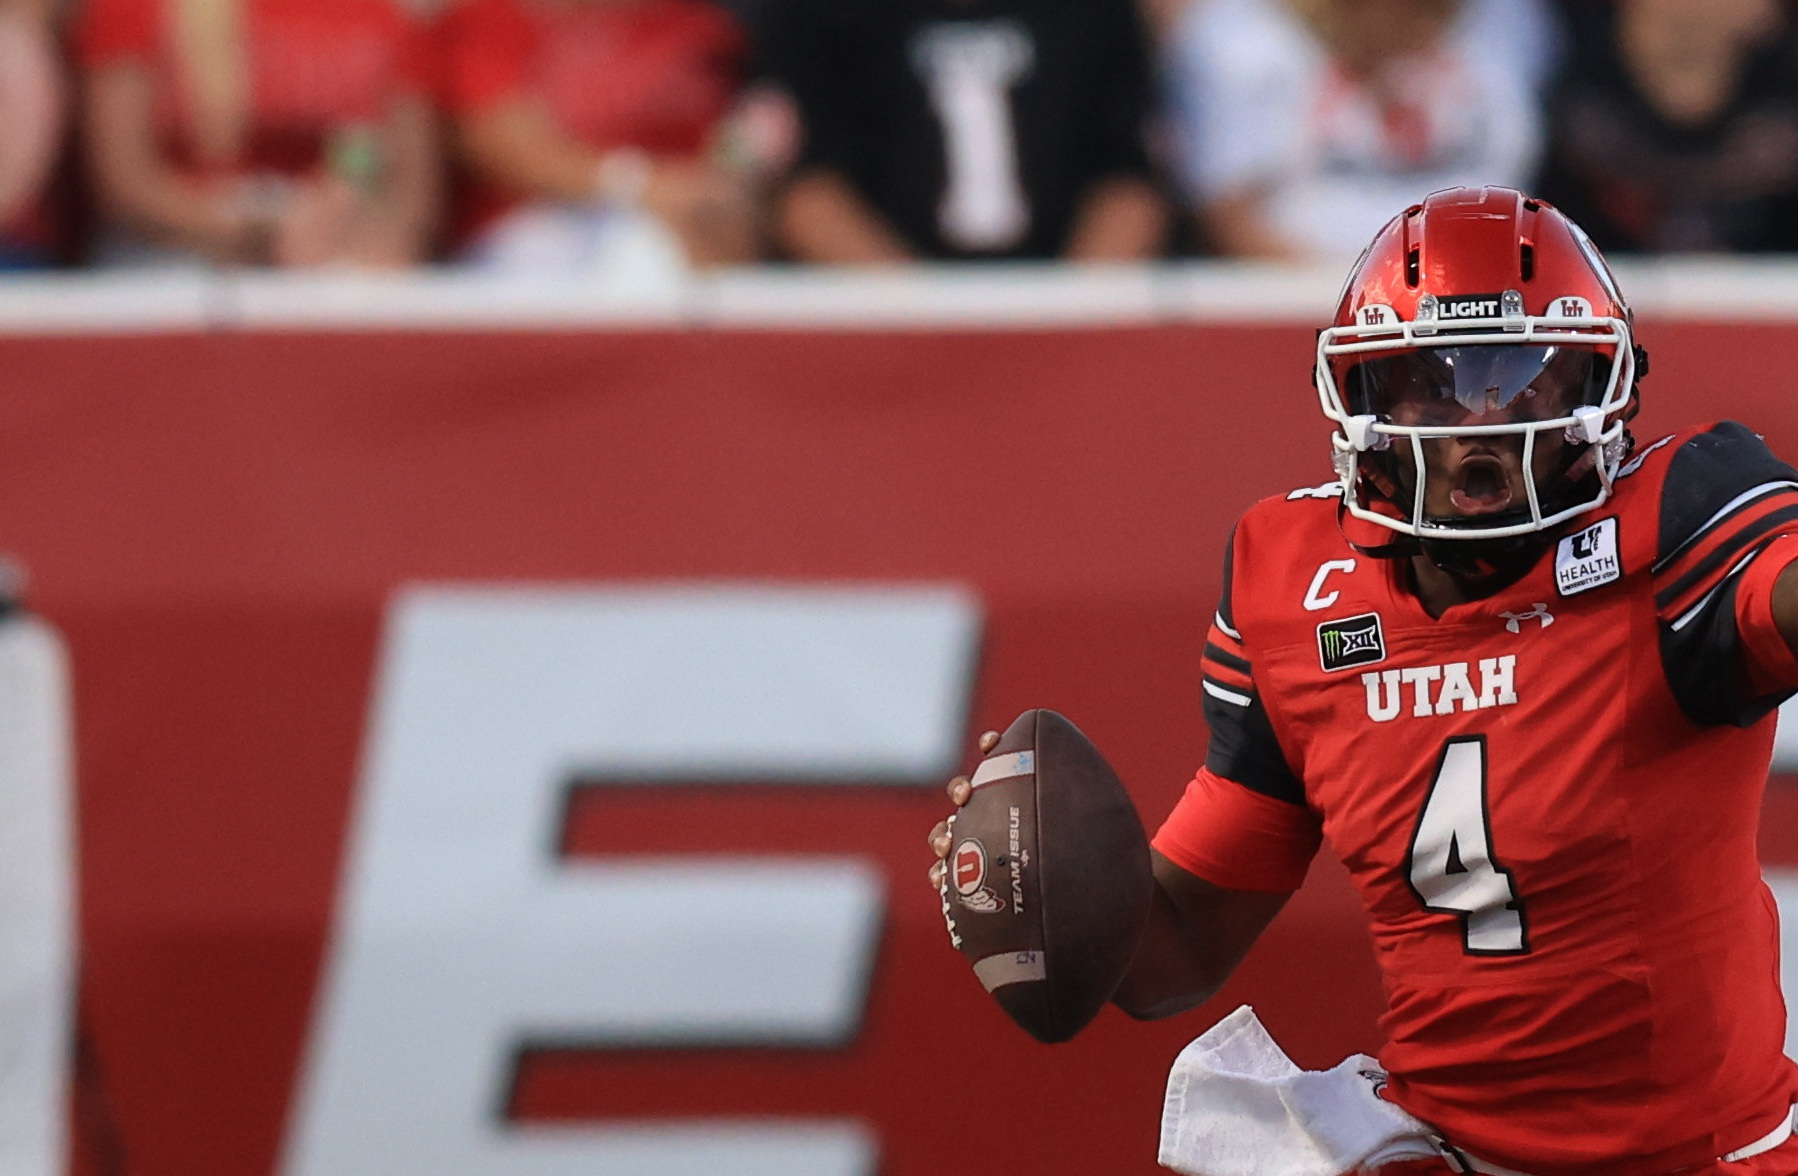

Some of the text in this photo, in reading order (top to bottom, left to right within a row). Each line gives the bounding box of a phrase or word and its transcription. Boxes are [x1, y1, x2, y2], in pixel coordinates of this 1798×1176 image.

[1439, 300, 1498, 318] LIGHT
[1303, 558, 1356, 611] C
[1559, 554, 1615, 583] HEALTH
[1361, 654, 1518, 723] UTAH
[956, 850, 982, 889] U
[1009, 806, 1024, 915] TEAM ISSUE
[1408, 734, 1531, 955] 4
